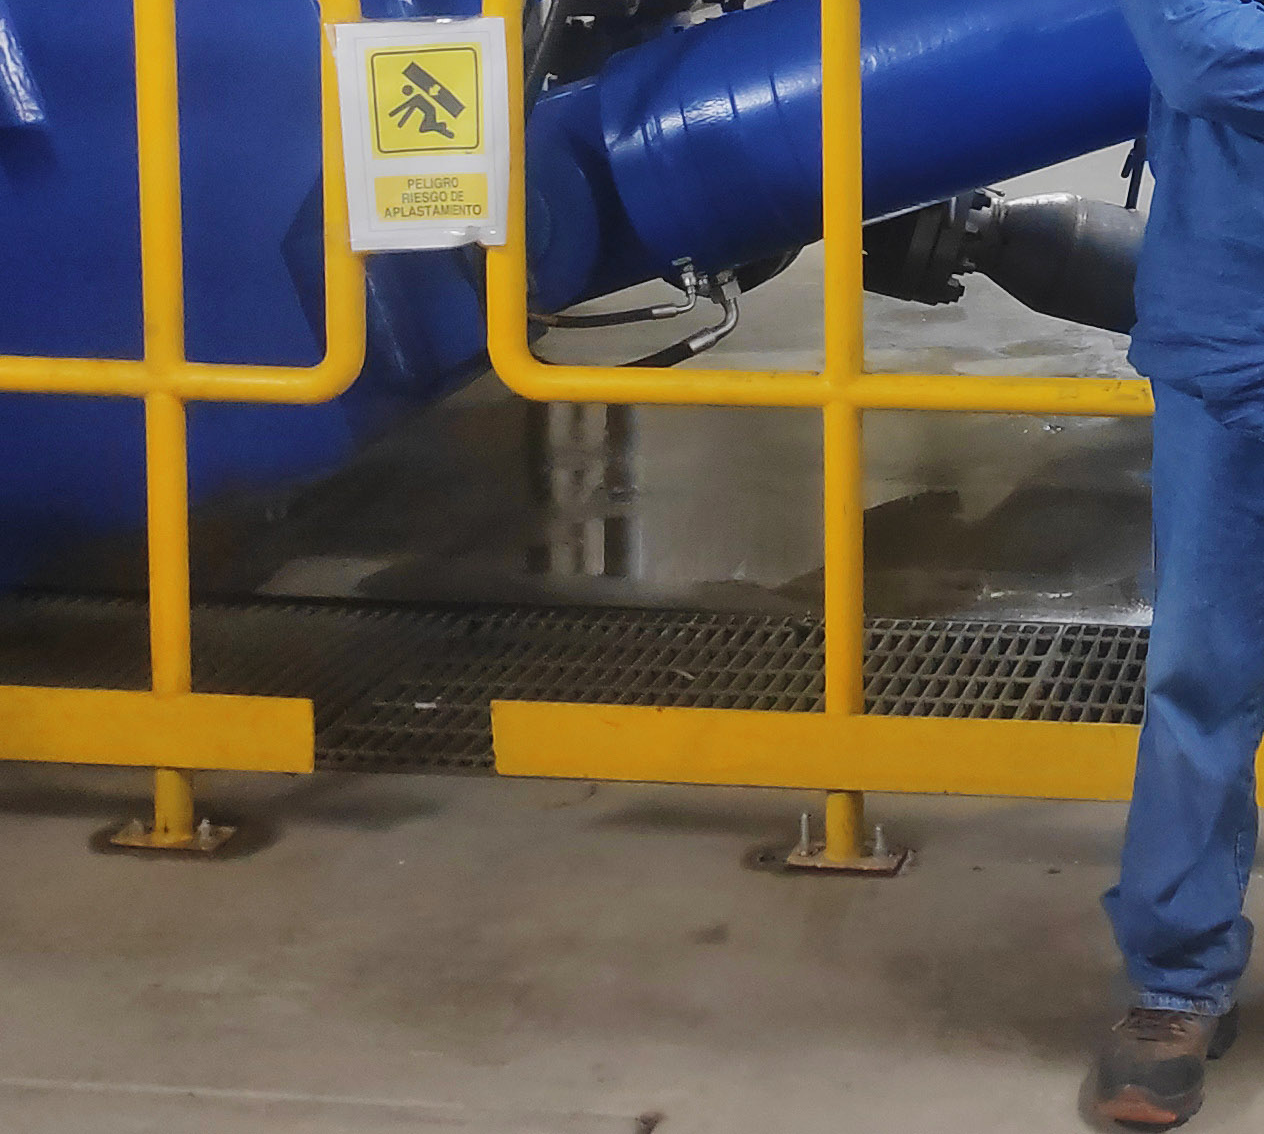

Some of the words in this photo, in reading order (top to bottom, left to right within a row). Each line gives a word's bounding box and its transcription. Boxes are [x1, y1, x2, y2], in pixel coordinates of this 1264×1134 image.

[407, 177, 459, 189] PELIGRO
[401, 190, 448, 204] RIESGO
[450, 190, 464, 202] DE
[384, 204, 482, 218] APLASTAMIENTO
